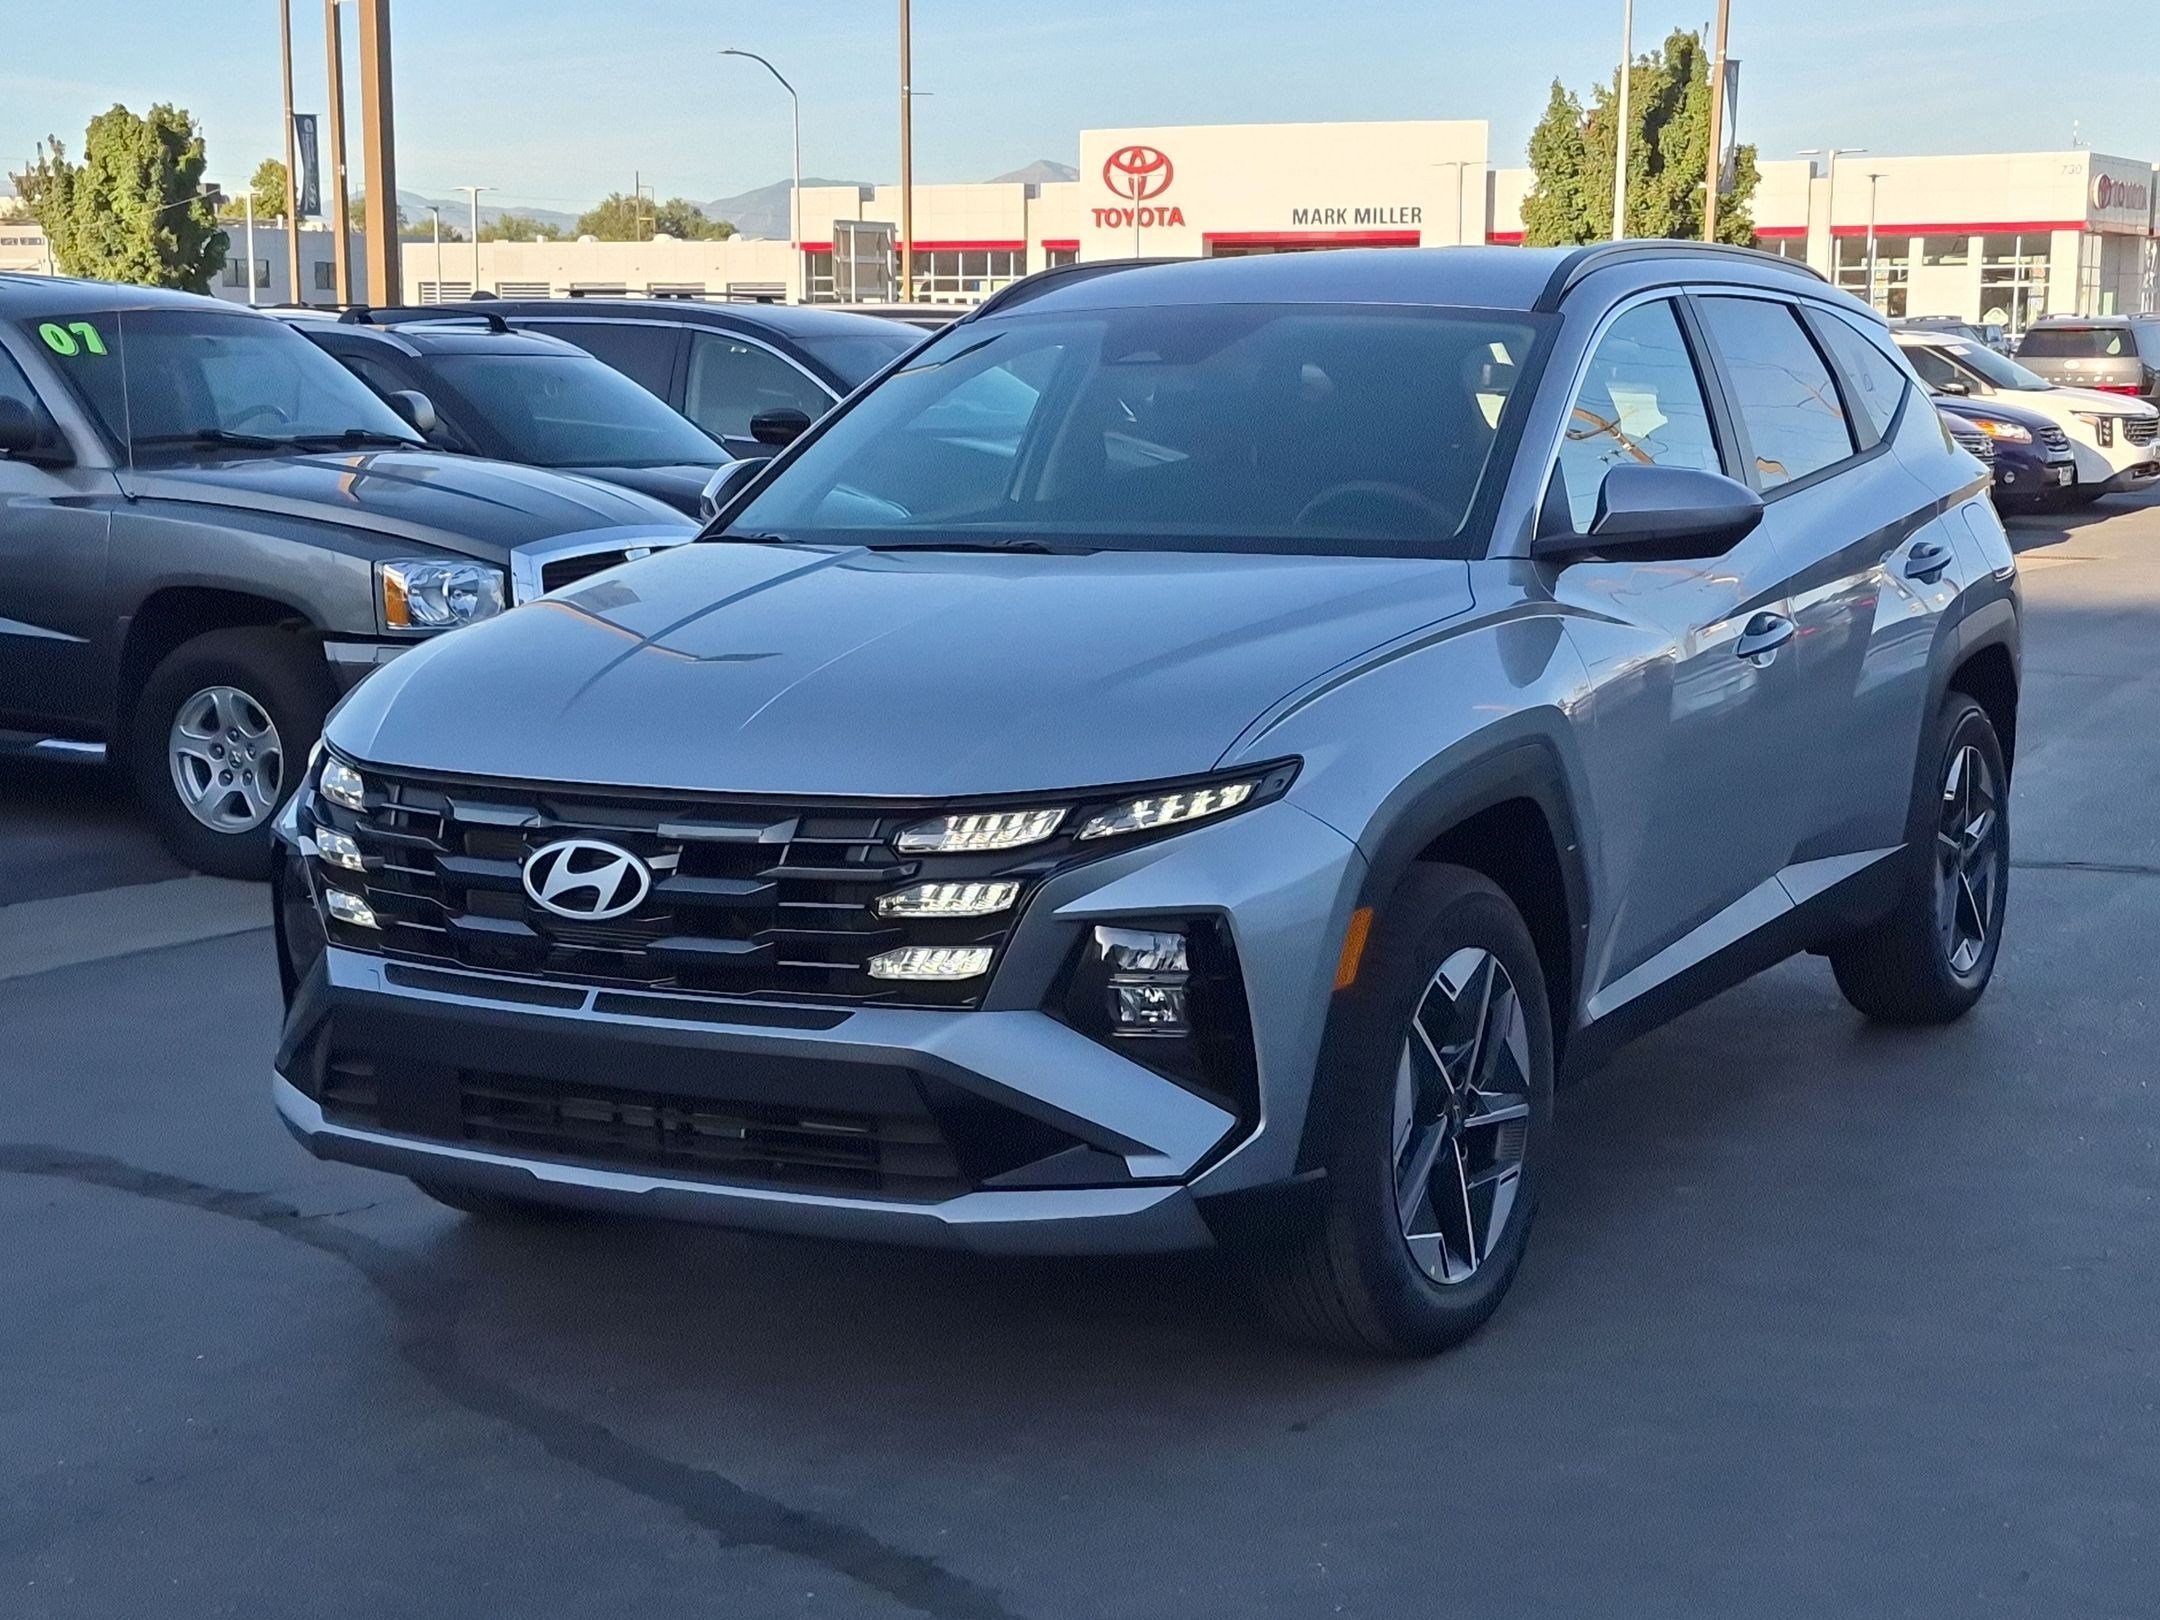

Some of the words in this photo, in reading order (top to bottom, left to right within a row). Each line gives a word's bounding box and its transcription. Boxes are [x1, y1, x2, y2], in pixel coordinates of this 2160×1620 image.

[1092, 207, 1185, 228] TOYOTA
[1292, 208, 1347, 225] MARK
[1354, 206, 1422, 225] MILLER
[39, 322, 108, 356] 07
